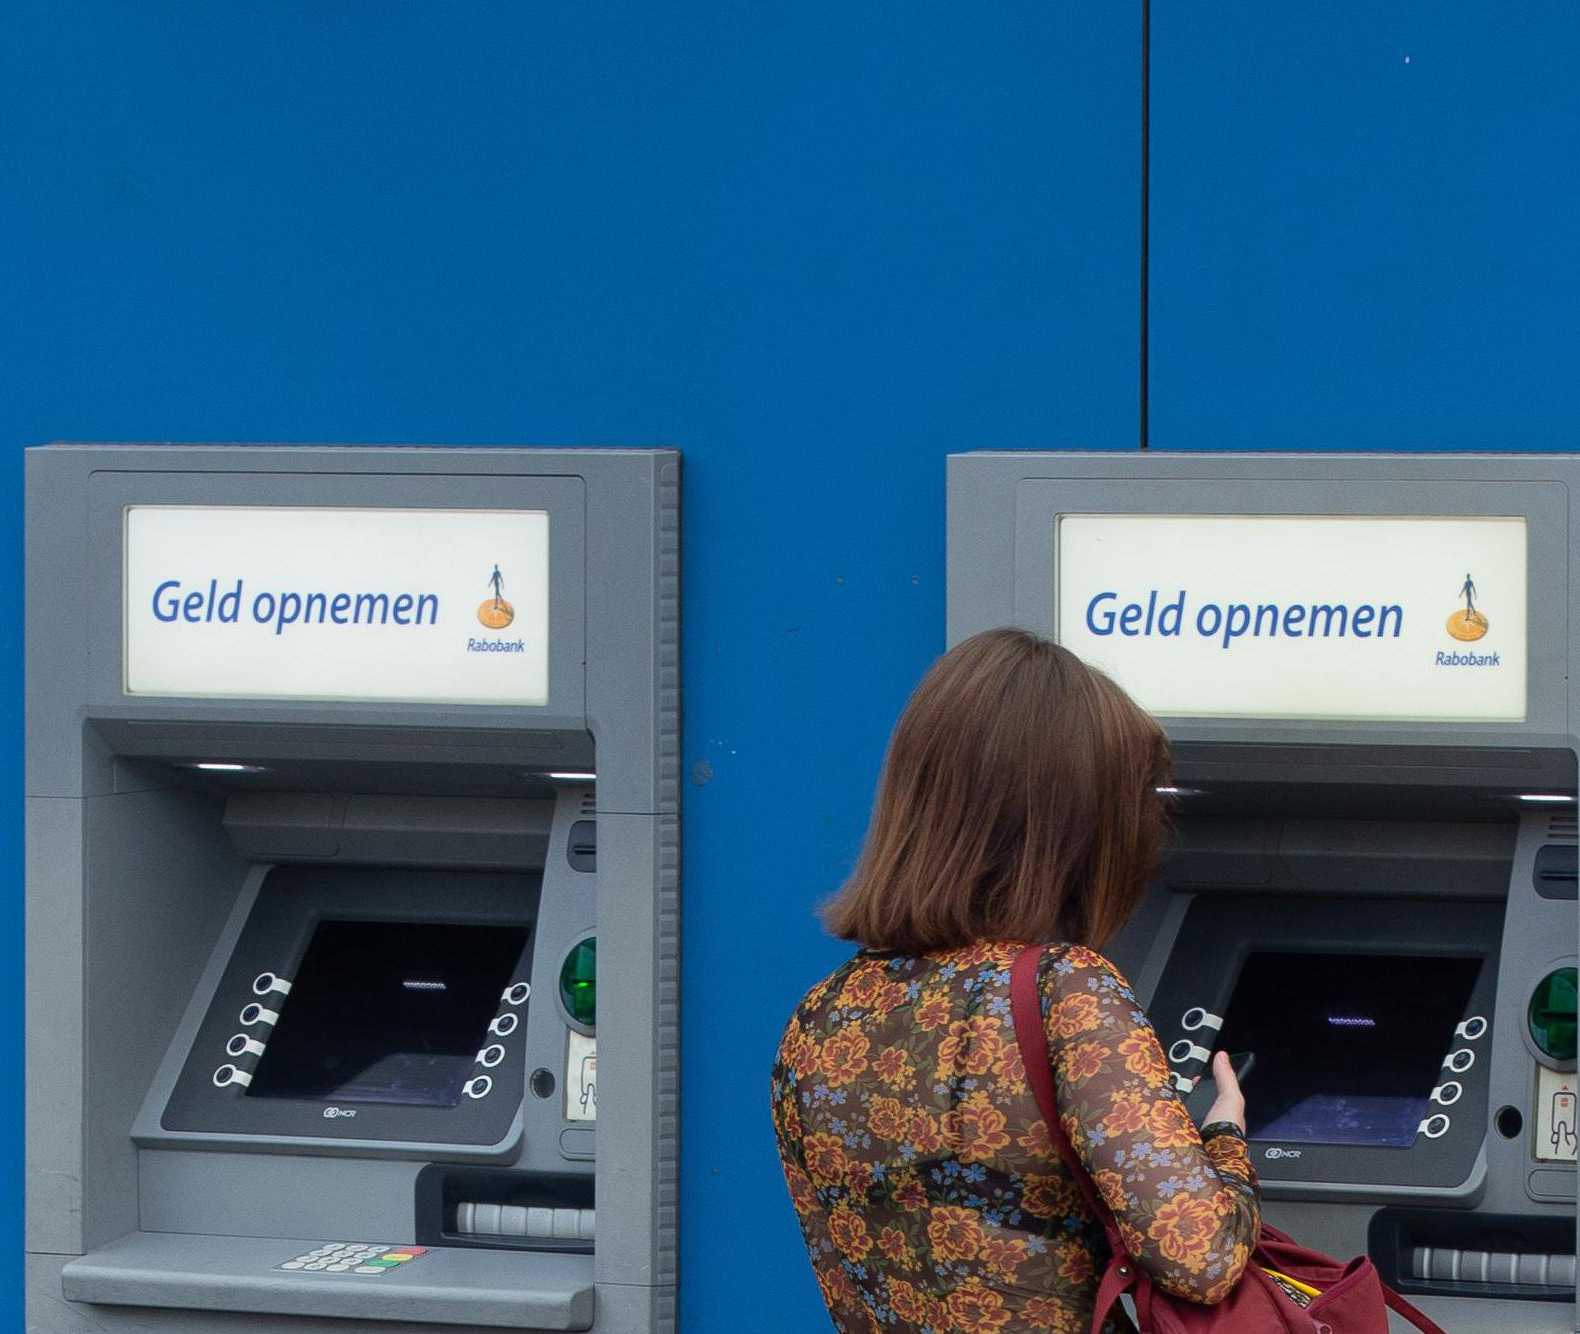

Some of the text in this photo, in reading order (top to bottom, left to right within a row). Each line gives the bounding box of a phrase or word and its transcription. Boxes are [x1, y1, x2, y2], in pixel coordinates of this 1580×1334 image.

[152, 578, 440, 635] Geld opnemen
[1085, 590, 1404, 649] Geld opnemen
[466, 637, 525, 654] Rabobank
[1434, 651, 1501, 667] Rabobank
